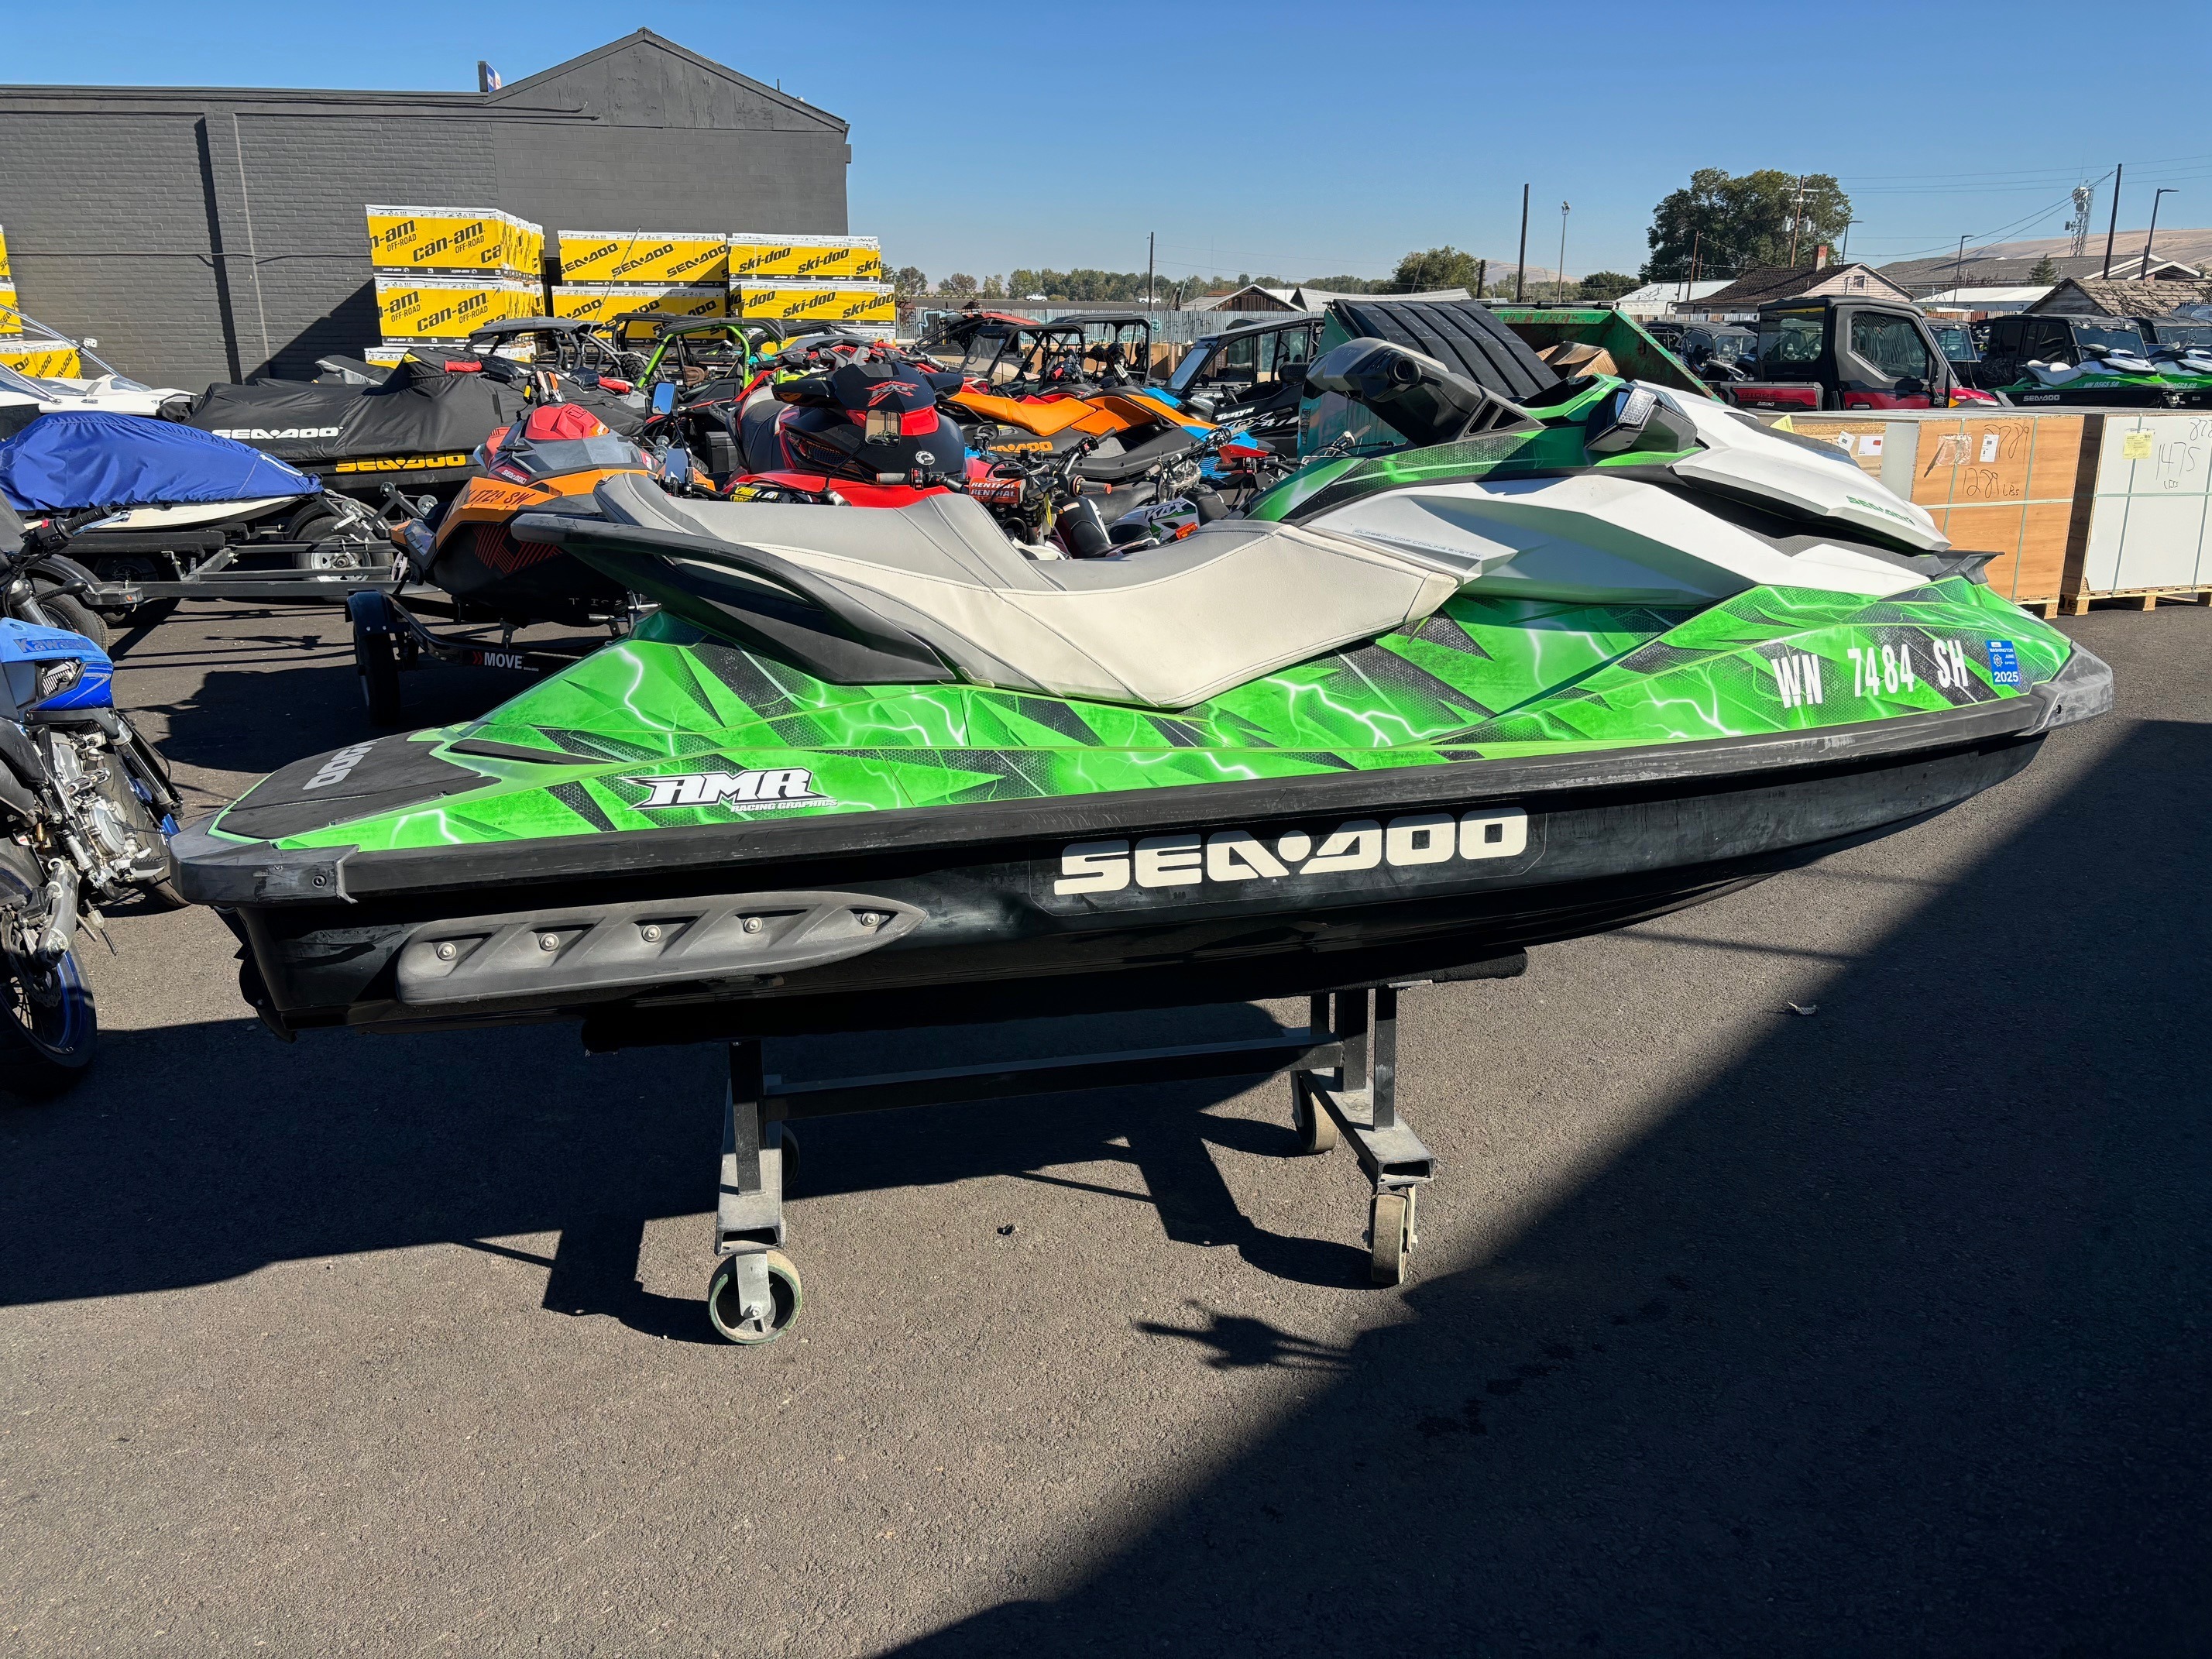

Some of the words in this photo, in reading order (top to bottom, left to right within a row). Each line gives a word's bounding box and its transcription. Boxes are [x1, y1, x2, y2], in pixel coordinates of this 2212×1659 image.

[387, 234, 417, 252] OFF-ROAD
[413, 222, 485, 263] can-am
[455, 235, 485, 254] OFF-ROAD
[738, 247, 792, 273] ski-doo
[798, 249, 850, 274] ski-doo
[391, 304, 421, 322] OFF-ROAD
[417, 292, 488, 332] can-am
[459, 305, 489, 325] OFF-ROAD
[782, 291, 836, 318] ski-doo
[842, 294, 895, 319] ski-doo
[970, 489, 1016, 497] RENTHAL
[1963, 467, 2000, 499] 1289
[1355, 529, 1411, 542] CLOSED-LOOP
[1412, 541, 1447, 550] COOLING
[1448, 548, 1482, 558] SYSTEM
[484, 652, 523, 670] MOVE
[1771, 654, 1823, 709] WN
[1846, 644, 1915, 697] 7484
[1932, 639, 1969, 689] SH
[1994, 671, 2019, 683] 2025
[622, 768, 830, 810] AMR
[730, 802, 776, 812] RACING
[777, 799, 838, 809] GRAPHICS
